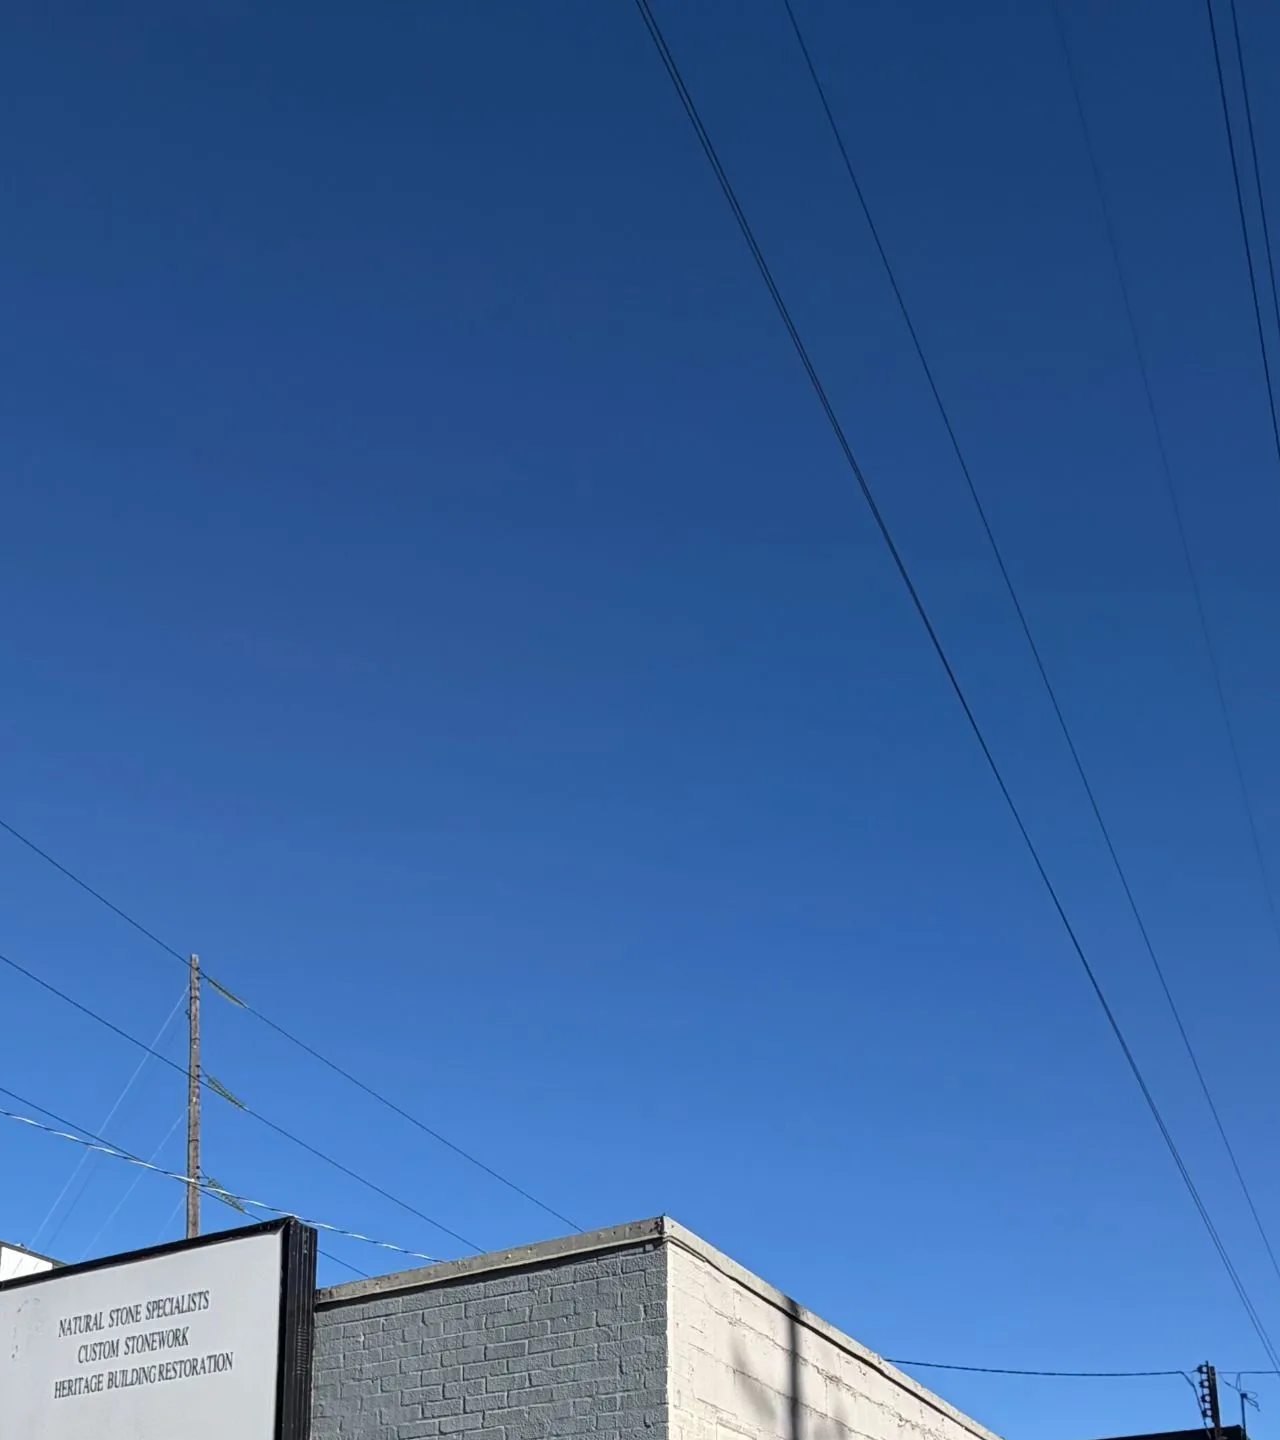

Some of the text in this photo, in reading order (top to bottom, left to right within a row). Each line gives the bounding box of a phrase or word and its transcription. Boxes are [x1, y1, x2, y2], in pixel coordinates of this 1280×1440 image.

[58, 1311, 105, 1338] NATURAL
[108, 1304, 142, 1329] STONE
[145, 1290, 210, 1320] SPECIALISTS
[78, 1326, 190, 1364] CUSTOM STONEWORK
[54, 1352, 234, 1399] HERITAGE BUILDING RESTORATION
